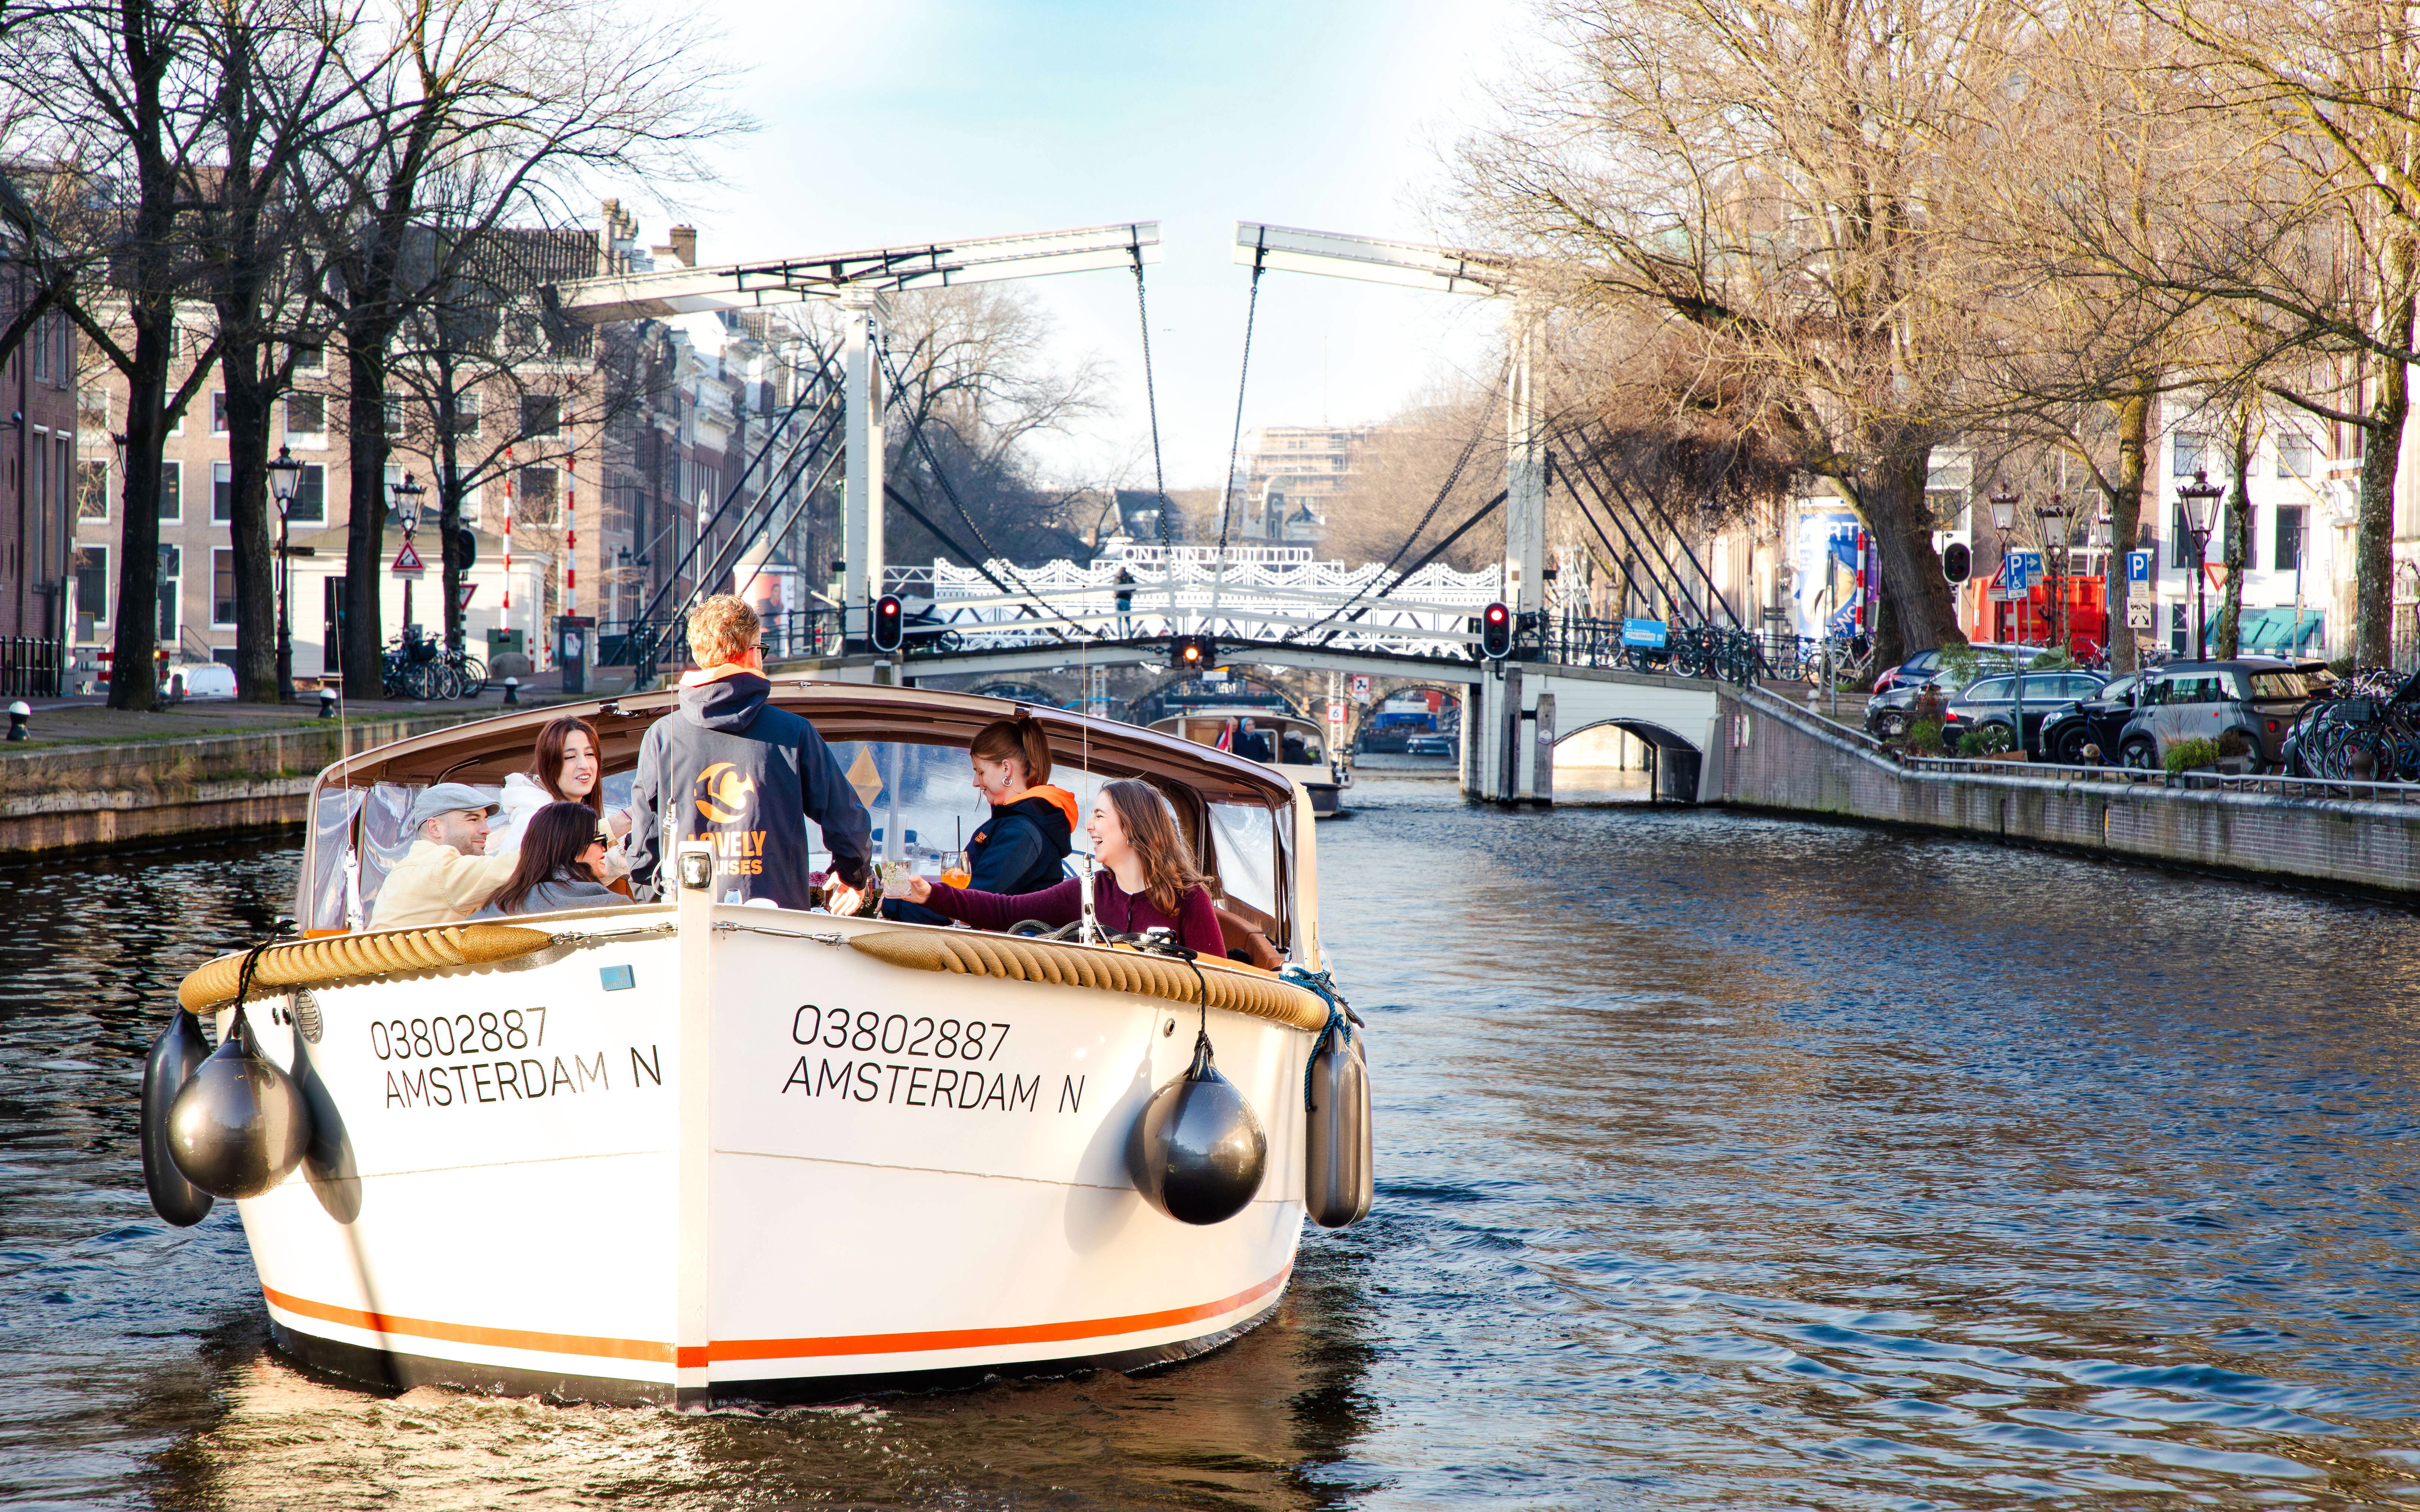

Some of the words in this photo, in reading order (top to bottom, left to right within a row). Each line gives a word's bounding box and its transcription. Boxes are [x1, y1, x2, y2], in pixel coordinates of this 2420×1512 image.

[2011, 555, 2022, 575] P
[2133, 556, 2144, 578] P
[1333, 709, 1339, 717] 6
[716, 859, 763, 875] UISES
[603, 979, 630, 989] B001926
[371, 1007, 546, 1060] 03802887
[793, 1005, 1010, 1061] 03802887
[387, 1052, 608, 1108] AMSTERDAM
[630, 1045, 661, 1087] N
[782, 1056, 1040, 1112] AMSTERDAM
[1059, 1075, 1085, 1113] N
